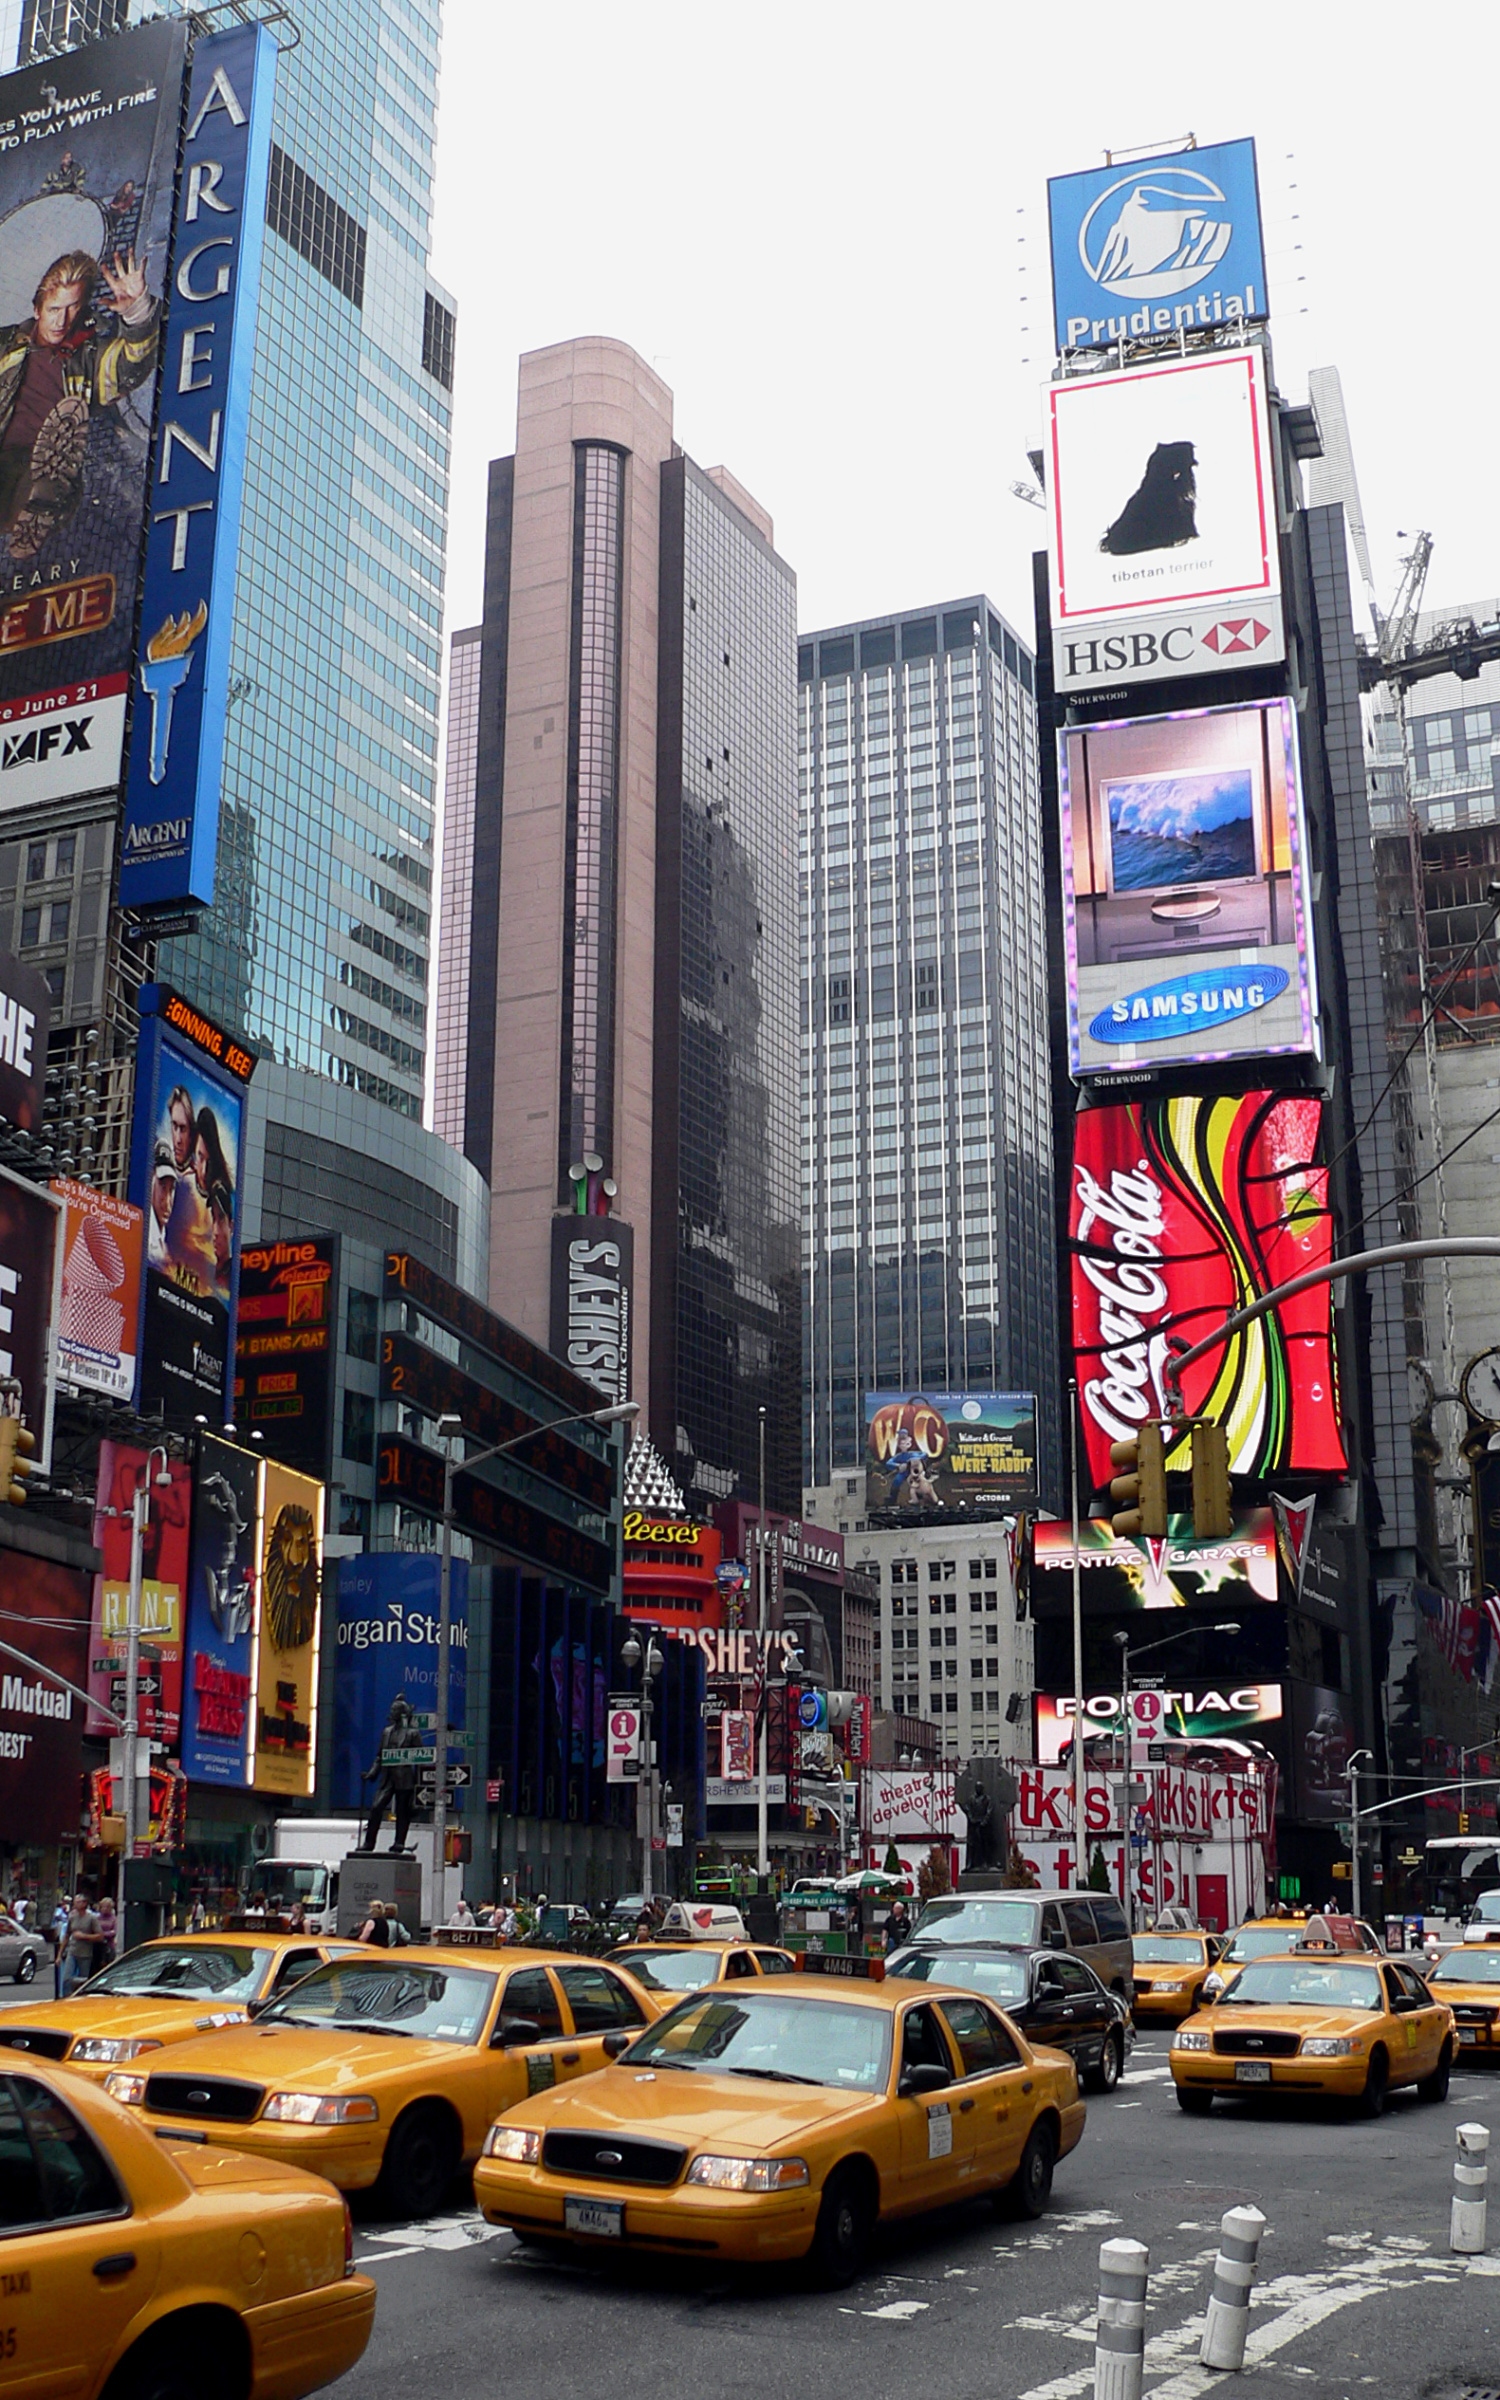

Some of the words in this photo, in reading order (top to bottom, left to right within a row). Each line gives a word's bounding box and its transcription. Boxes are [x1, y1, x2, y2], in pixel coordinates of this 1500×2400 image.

[0, 136, 20, 151] TO
[24, 119, 66, 144] PLAY
[69, 104, 113, 128] WITH
[117, 88, 157, 112] FIRE
[20, 107, 52, 126] YOU
[55, 90, 102, 115] HAVE
[154, 64, 249, 571] ARGENT
[1066, 285, 1256, 346] Prudential
[1112, 566, 1165, 583] tibetan
[1169, 559, 1214, 575] terrier
[43, 582, 108, 635] ME
[1063, 626, 1195, 677] HSBC
[20, 693, 68, 717] June
[76, 683, 98, 700] 21
[1069, 691, 1128, 707] SHERWOOD
[37, 715, 95, 763] FX
[124, 819, 188, 850] ARGENT
[1112, 985, 1265, 1022] SAMSUNG
[1094, 1073, 1151, 1087] SHERWOOD
[63, 1191, 88, 1212] You're
[90, 1204, 130, 1230] Organized
[78, 1186, 99, 1204] More
[101, 1195, 116, 1211] Fun
[117, 1203, 139, 1221] When
[618, 1286, 628, 1363] Chocolate
[260, 1375, 295, 1392] PRICE
[618, 1366, 628, 1403] Milk
[914, 1409, 945, 1458] G
[973, 1444, 1006, 1457] CURSE
[951, 1454, 1034, 1473] WERE-RABBIT
[975, 1494, 1011, 1502] OCTOBER
[623, 1511, 702, 1544] Reese's
[1044, 1553, 1142, 1571] PONTIAC
[1170, 1545, 1268, 1563] GARAGE
[105, 1592, 176, 1630] RNT
[1, 1674, 72, 1721] Mutual
[850, 1702, 864, 1757] Twizzlers
[382, 1750, 405, 1760] LITTLE
[408, 1748, 434, 1759] BRAZIL
[822, 1958, 853, 1975] 4M46
[0, 2270, 31, 2298] TAXI
